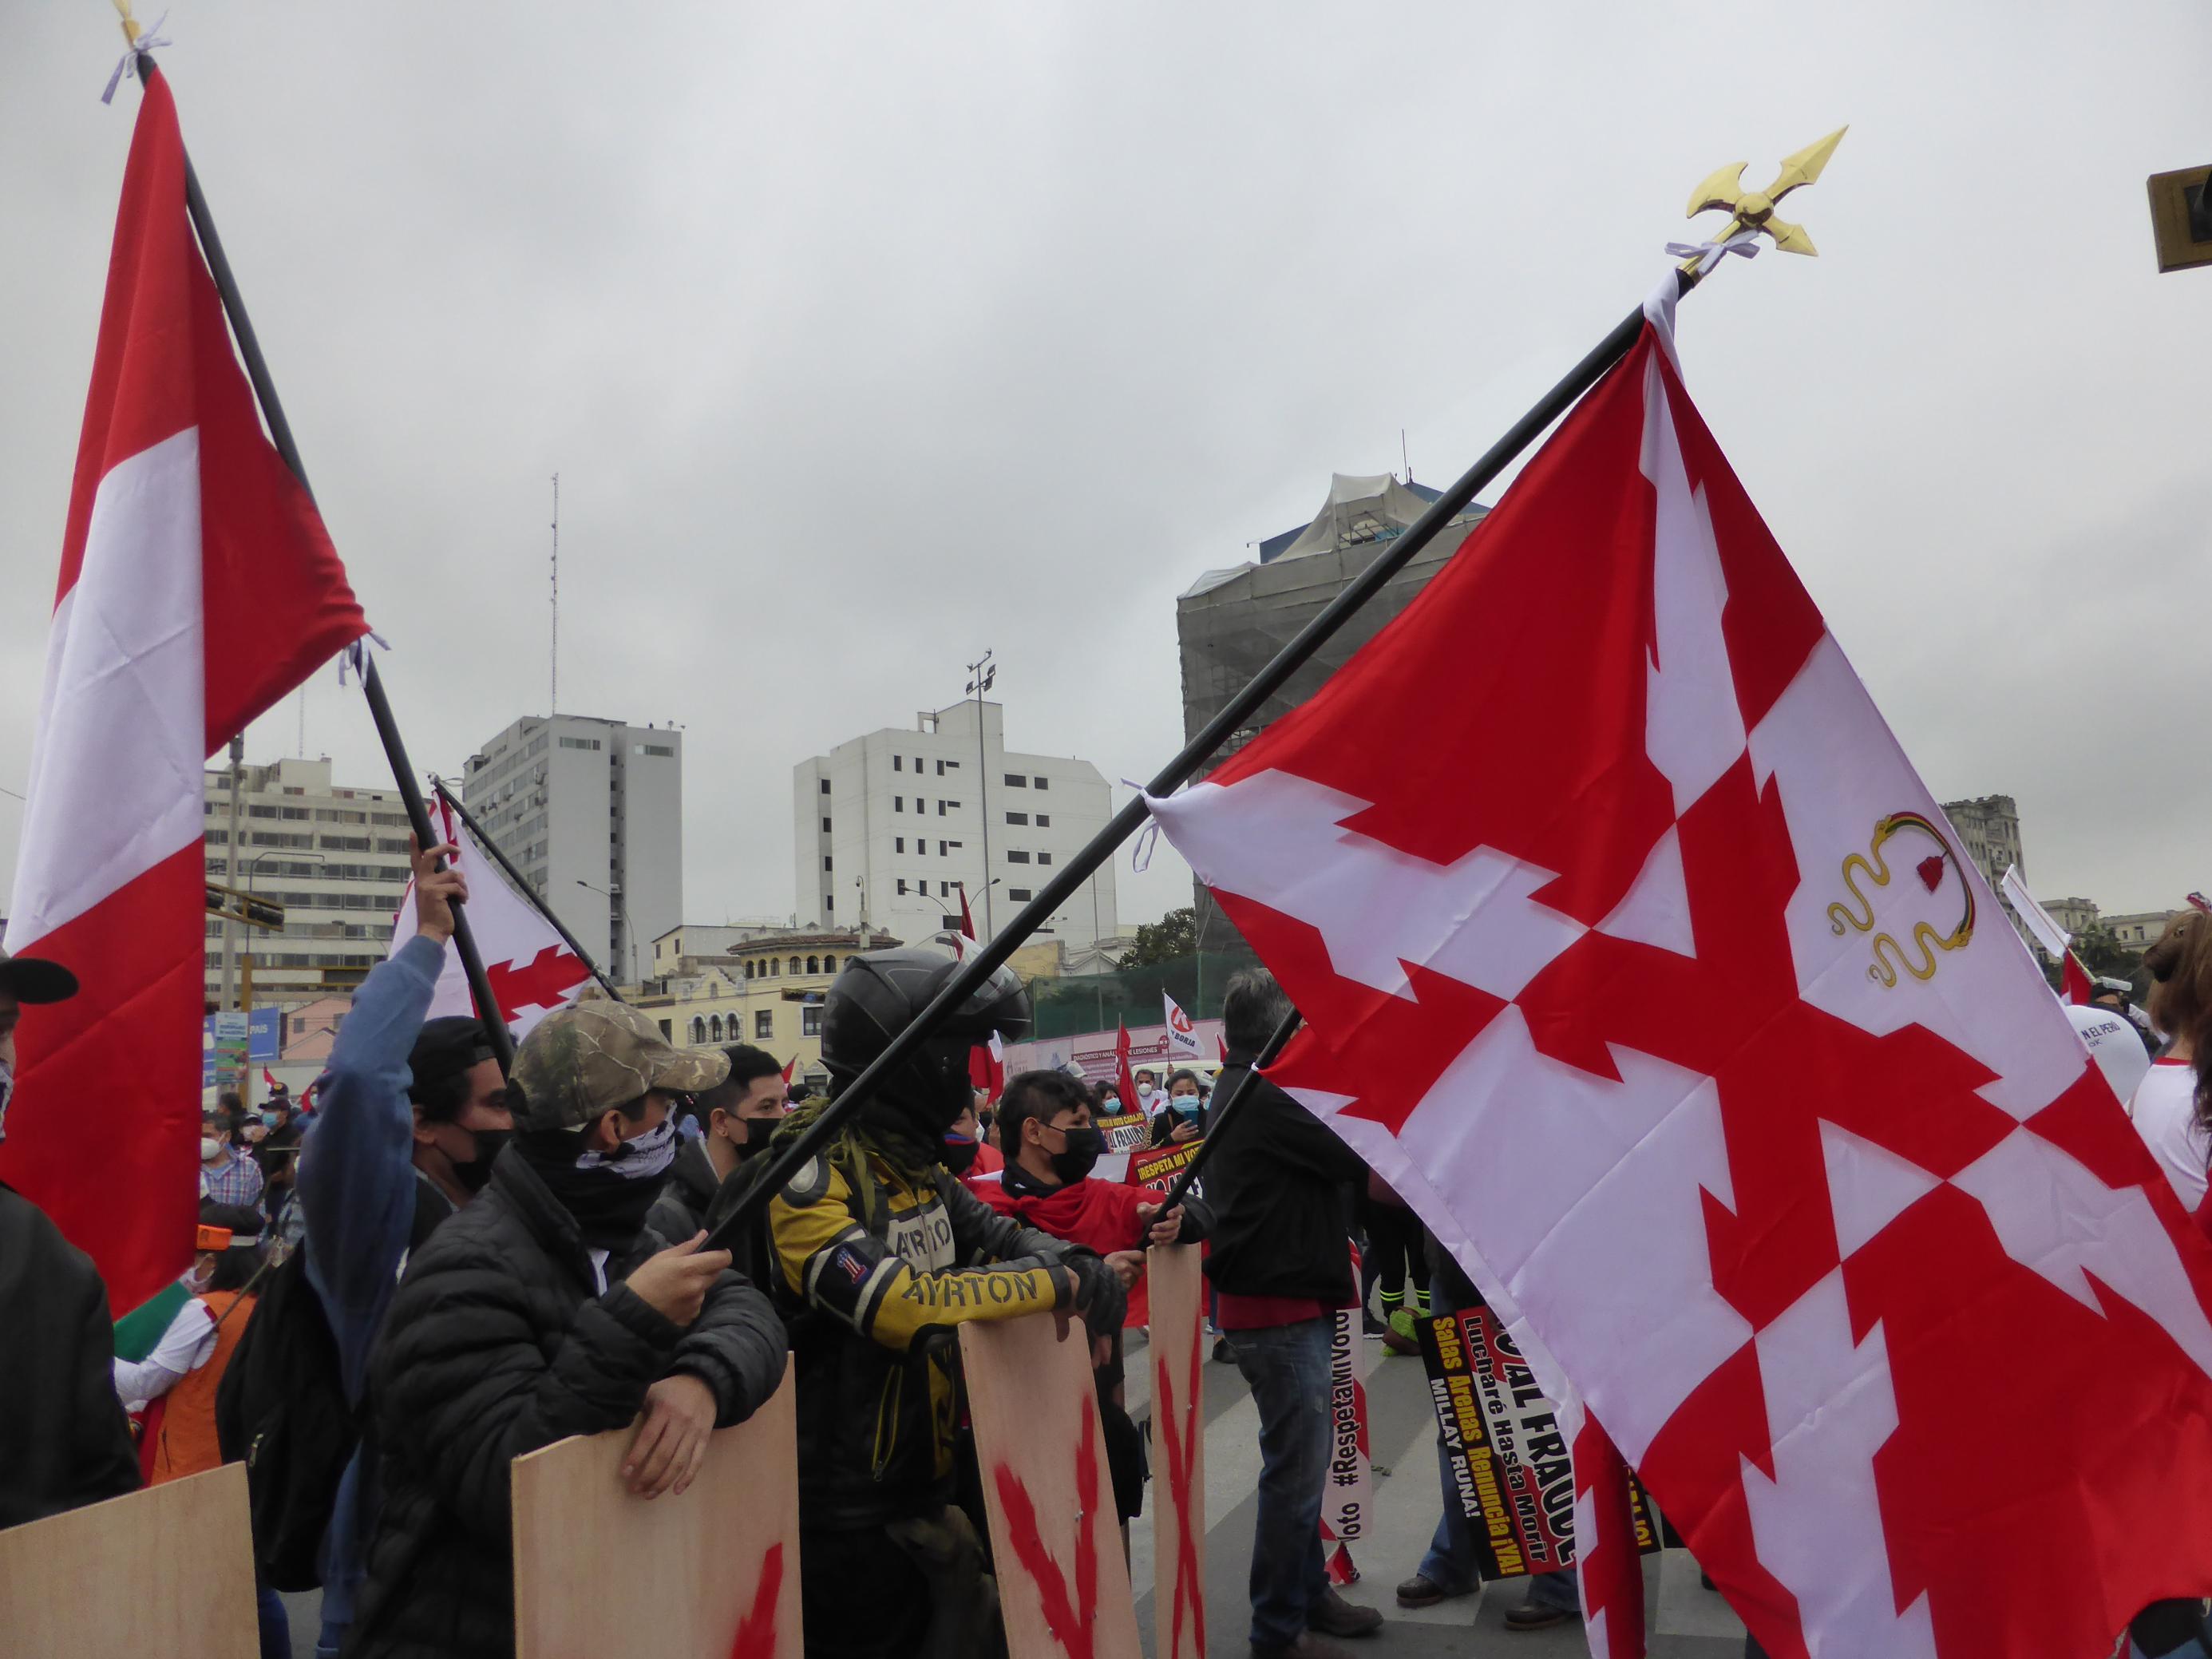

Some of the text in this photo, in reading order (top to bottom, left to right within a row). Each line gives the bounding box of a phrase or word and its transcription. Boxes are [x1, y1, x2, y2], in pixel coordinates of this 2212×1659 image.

[1174, 1032, 1196, 1047] BORJA
[2088, 1025, 2103, 1038] EL
[1114, 1124, 1146, 1147] FRAUD
[1173, 1153, 1185, 1166] MI
[1184, 1146, 1201, 1162] VOT
[901, 1273, 1038, 1307] AYRTON
[1433, 1317, 1462, 1369] Salas
[1447, 1375, 1482, 1441] Arenas
[1502, 1363, 1545, 1408] AL
[1430, 1378, 1482, 1518] MILLAY RUNA!
[1464, 1317, 1549, 1562] Lucharé Hasta Morir
[1467, 1446, 1510, 1537] Renuncia
